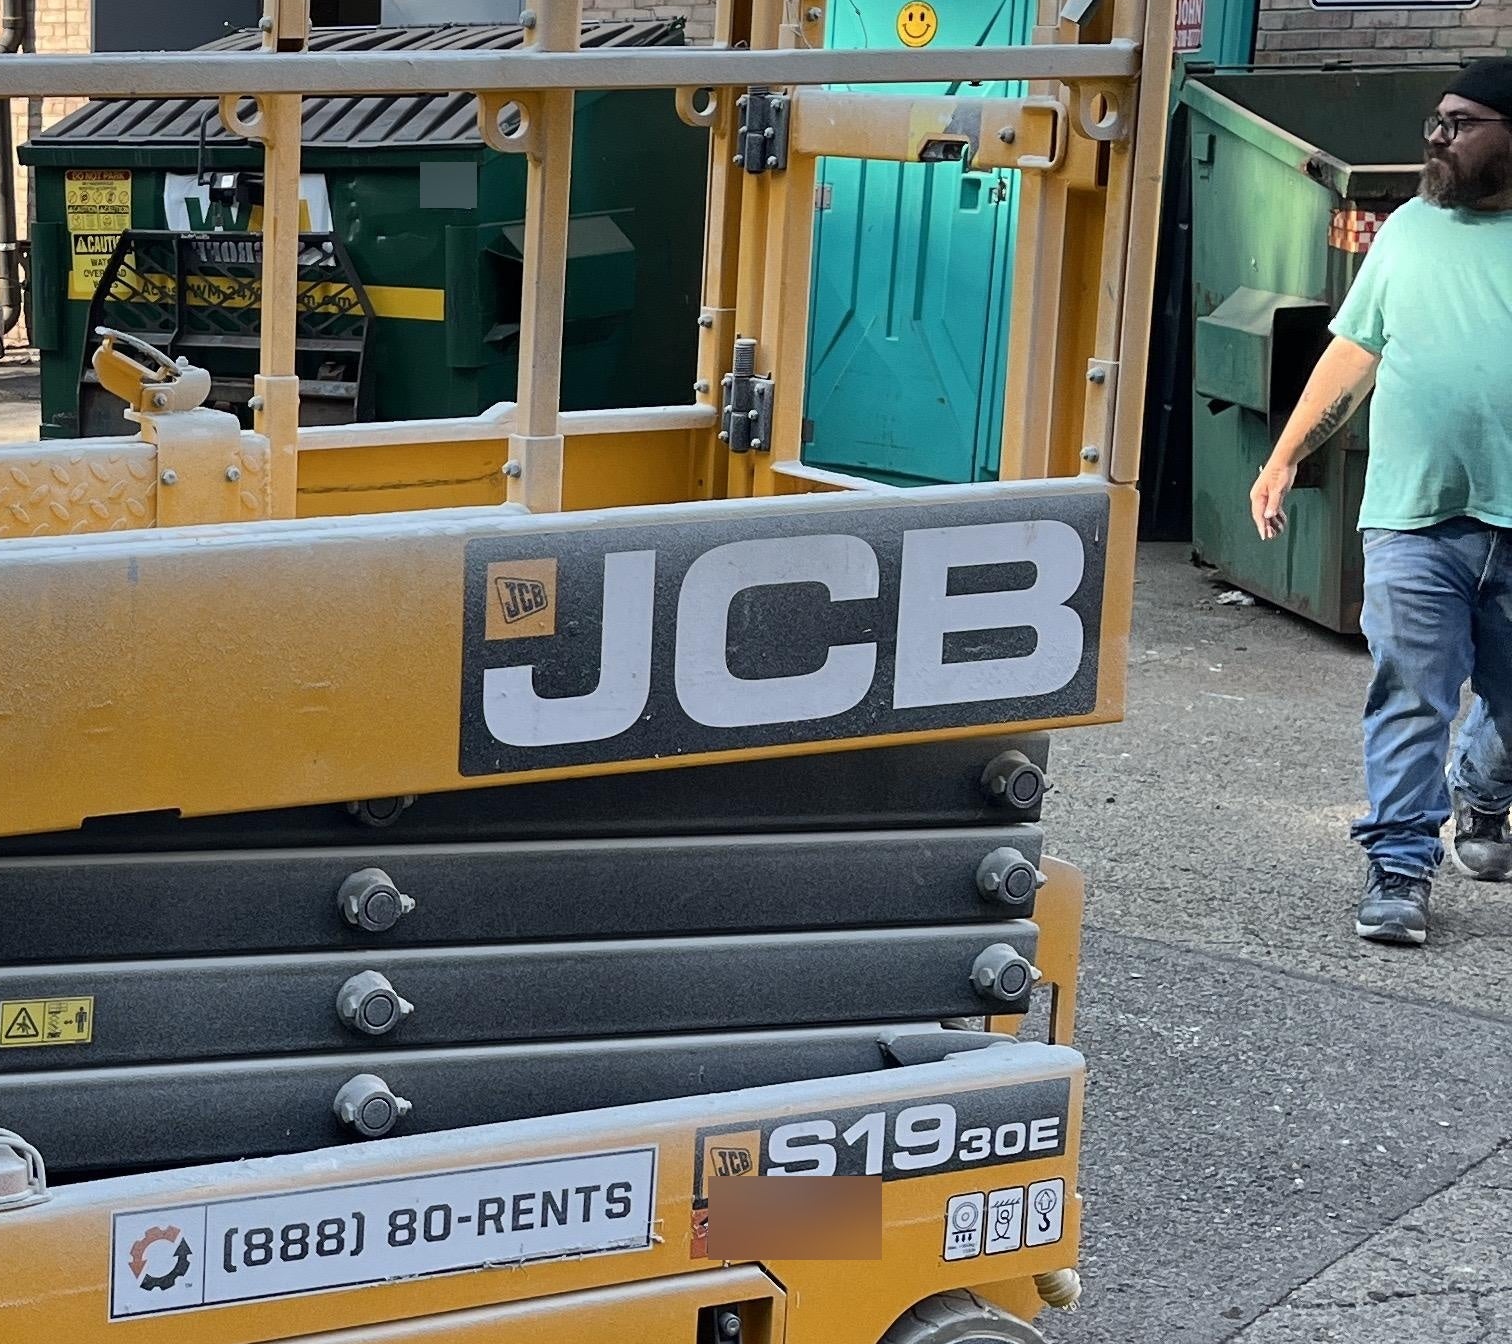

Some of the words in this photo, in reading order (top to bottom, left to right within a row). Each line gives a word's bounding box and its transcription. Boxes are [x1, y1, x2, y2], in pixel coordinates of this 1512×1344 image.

[483, 518, 1086, 748] JCB
[503, 581, 545, 619] JCB
[717, 1150, 750, 1177] JCB
[222, 1212, 366, 1274] (888)
[387, 1180, 633, 1248] 80-RENTS
